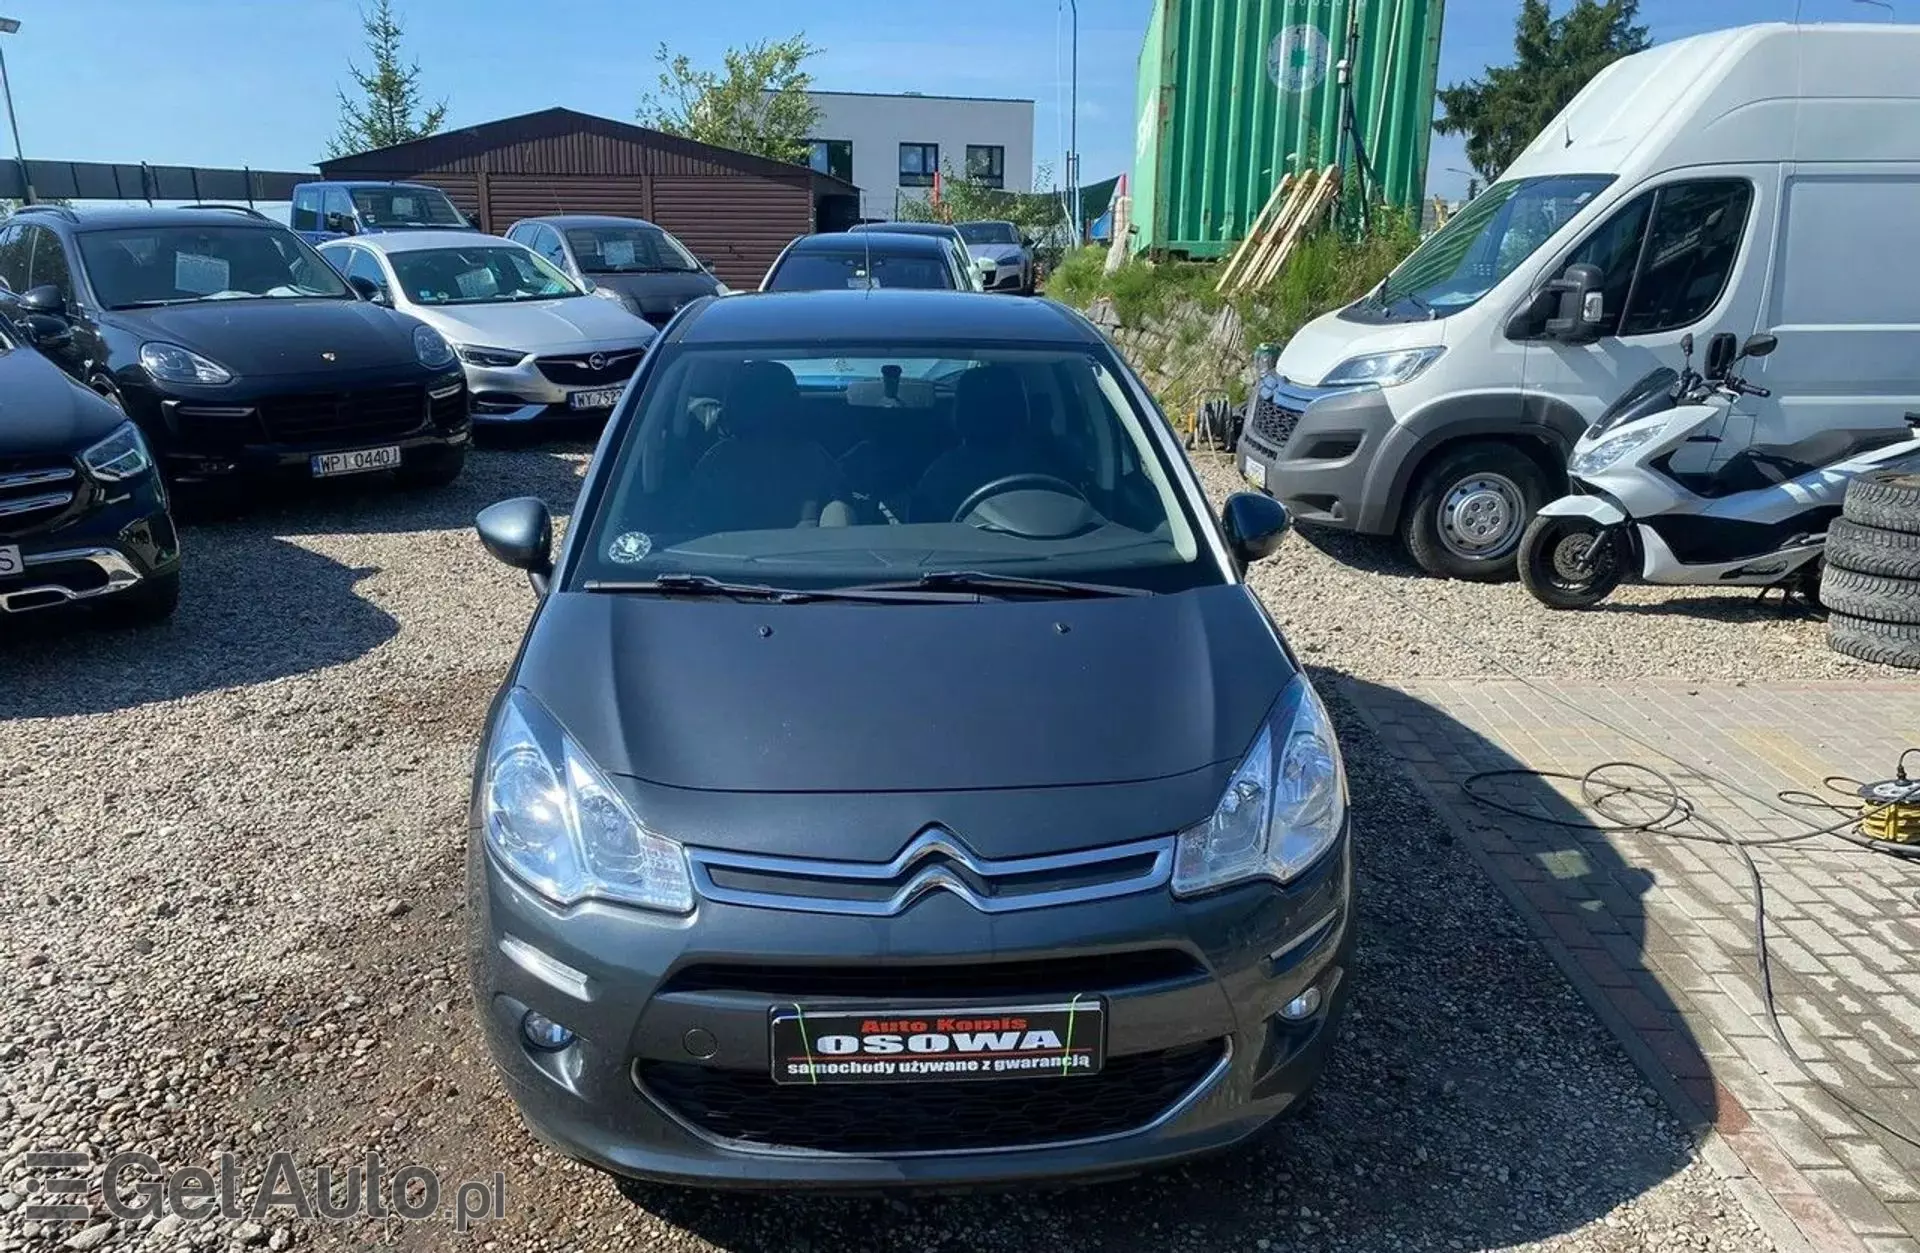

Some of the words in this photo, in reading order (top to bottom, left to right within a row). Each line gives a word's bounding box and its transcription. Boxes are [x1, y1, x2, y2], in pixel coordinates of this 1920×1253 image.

[320, 455, 348, 471] WPI
[861, 1018, 928, 1033] Auto
[936, 1016, 1027, 1032] Komis
[816, 1030, 1062, 1055] OSOWA
[787, 1060, 897, 1075] samochody
[899, 1059, 980, 1074] używane
[982, 1060, 991, 1071] z
[994, 1054, 1090, 1072] gwarancją
